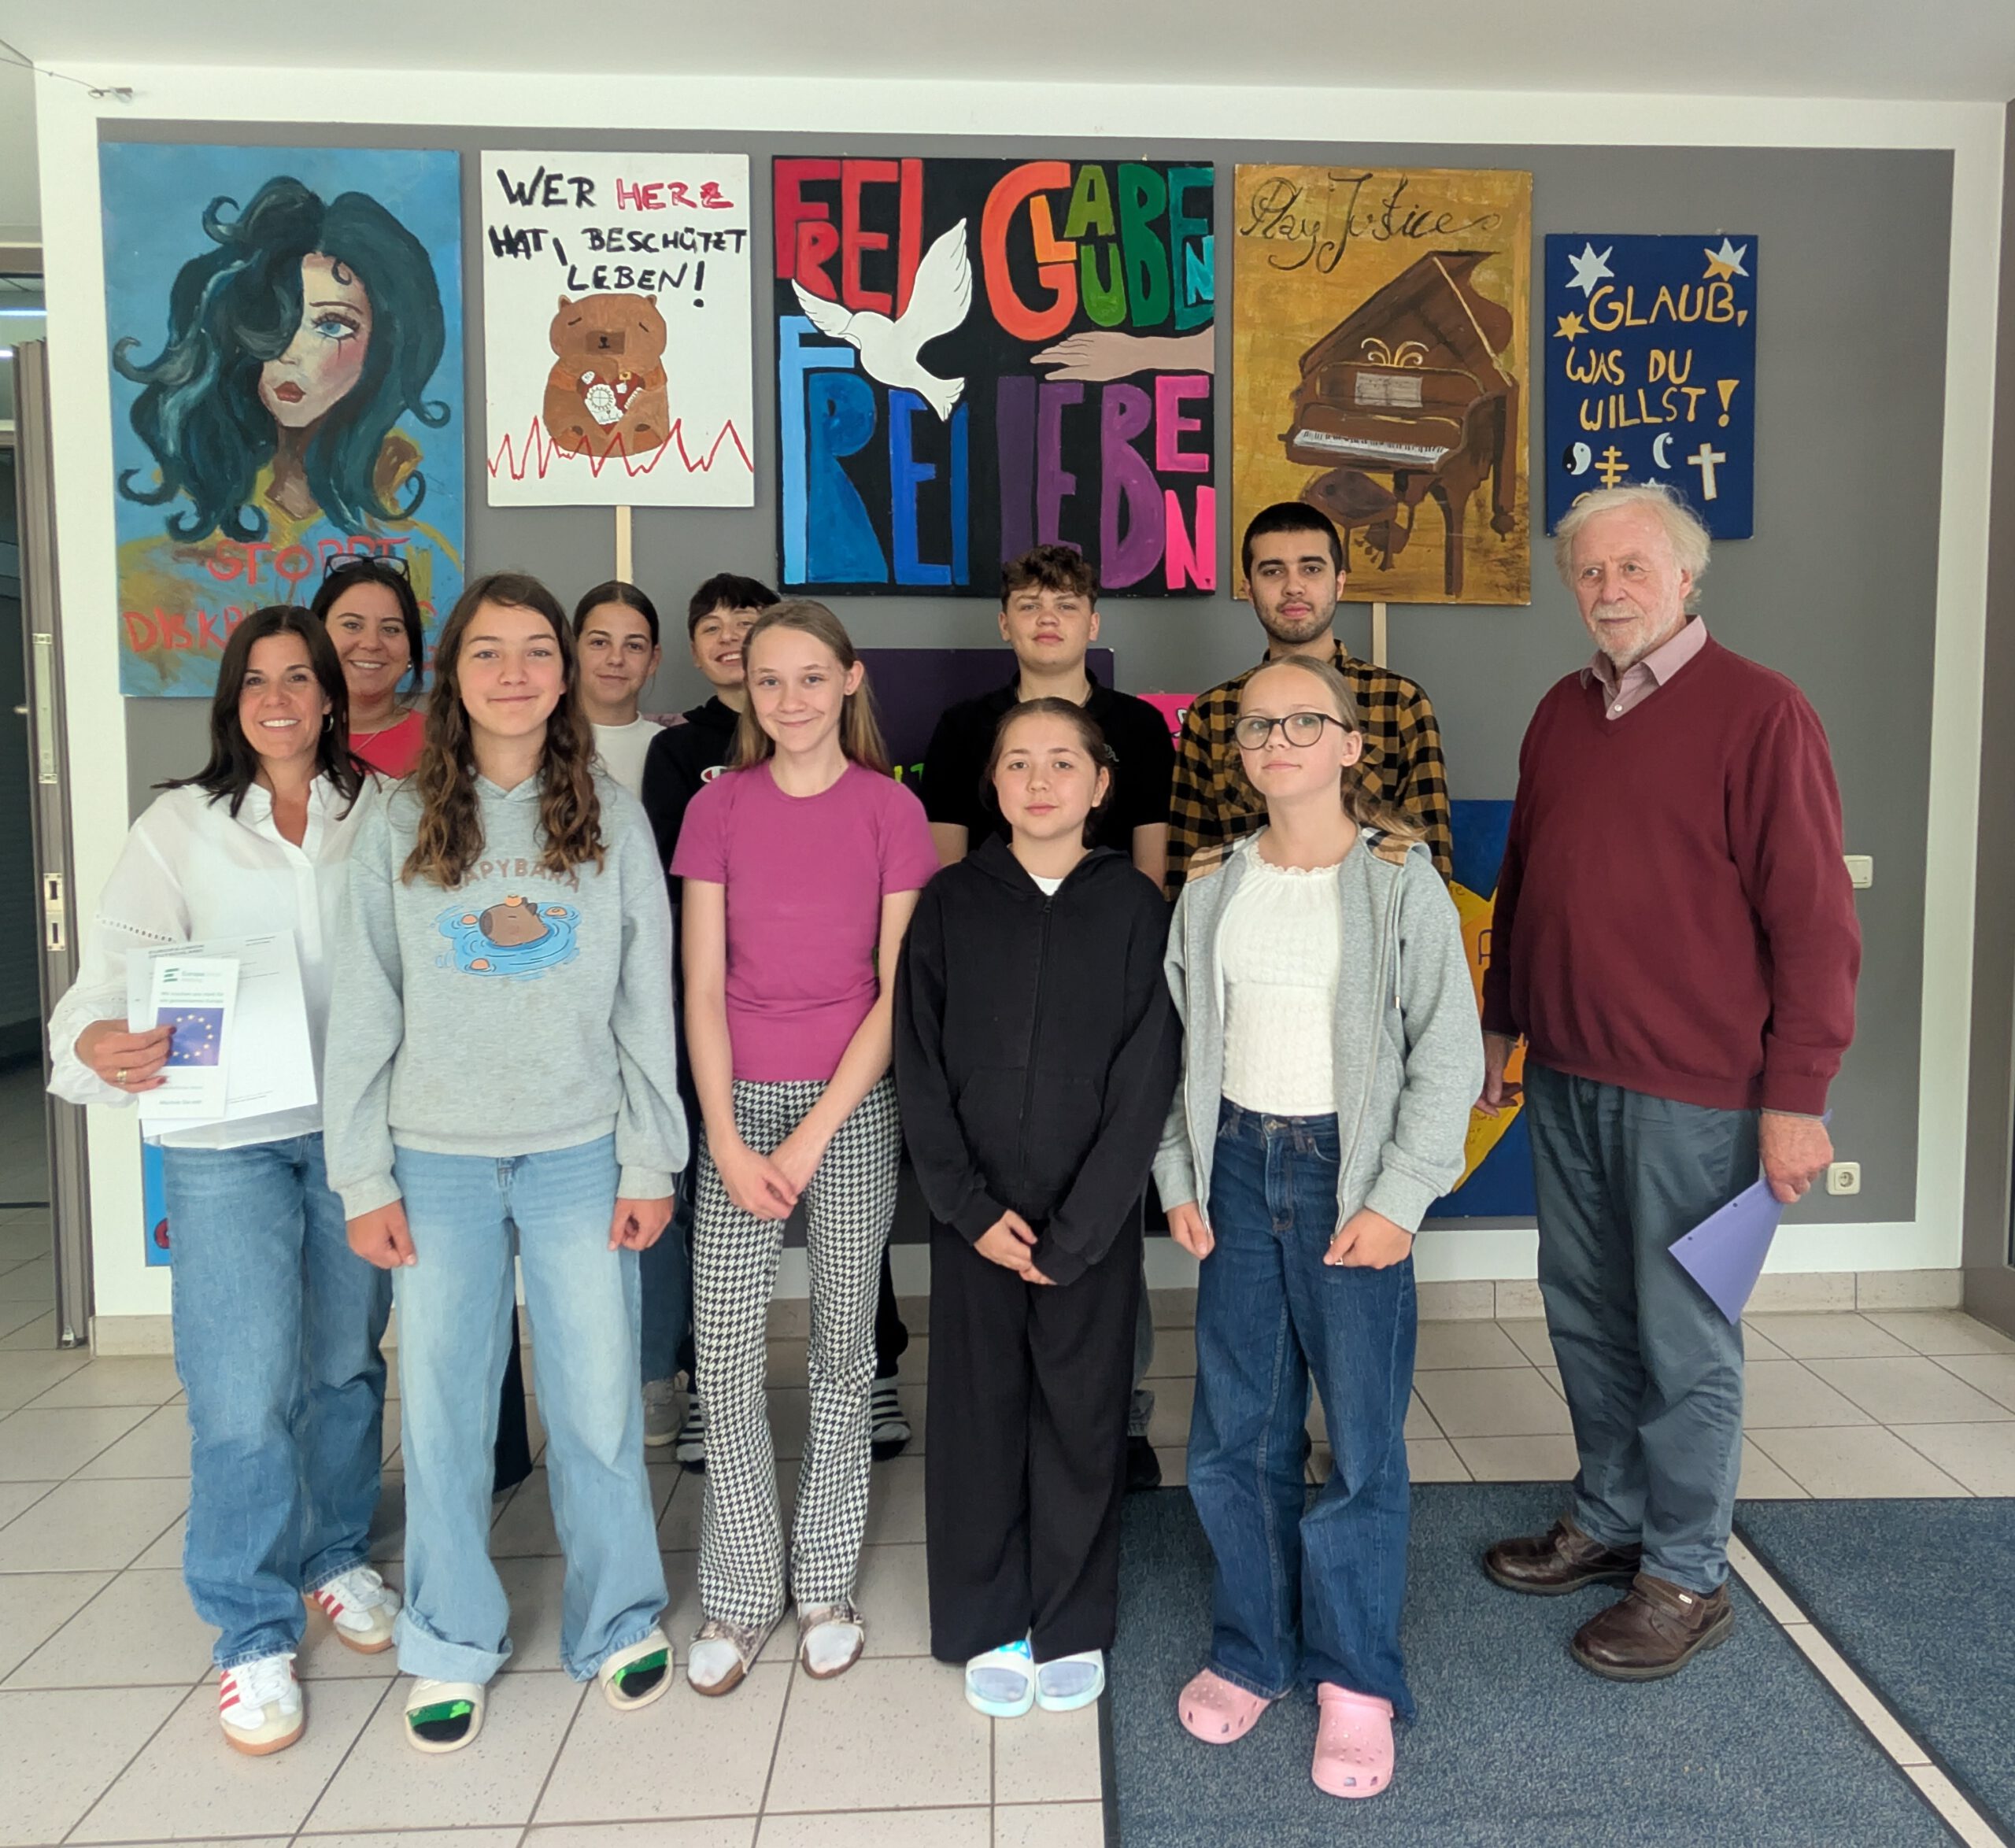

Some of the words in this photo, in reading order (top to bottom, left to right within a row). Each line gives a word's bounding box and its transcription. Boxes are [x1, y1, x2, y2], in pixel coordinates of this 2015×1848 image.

[497, 165, 597, 208] WER
[487, 224, 568, 267] HAT,
[580, 227, 747, 254] BESCHÜTZT
[1240, 176, 1321, 271] Play
[774, 158, 924, 320] FREI
[981, 161, 1215, 341] GLAUBEN
[567, 261, 706, 309] LEBEN!
[1588, 282, 1748, 331] GLAUB,
[1565, 346, 1625, 386] WAS
[1648, 349, 1693, 384] DU
[779, 316, 969, 586] FREI
